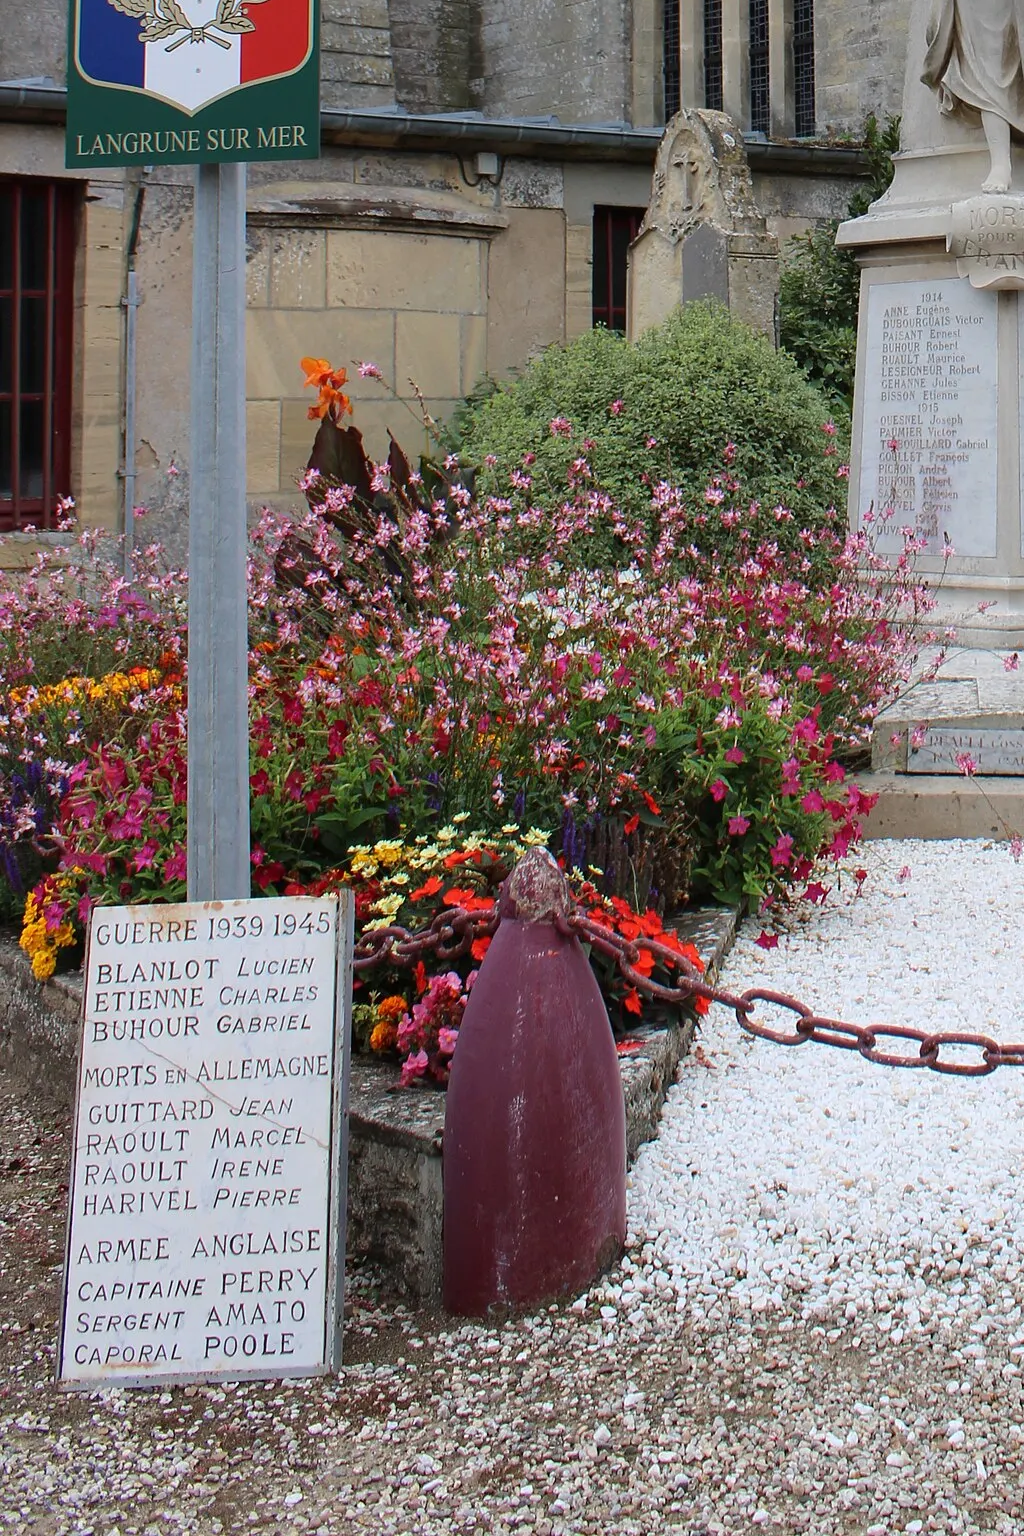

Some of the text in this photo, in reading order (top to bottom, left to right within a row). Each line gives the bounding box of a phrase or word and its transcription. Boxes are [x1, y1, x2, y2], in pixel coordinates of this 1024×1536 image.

[75, 125, 307, 155] LANGRUNE SUR MER
[977, 232, 1015, 243] POUR
[921, 292, 943, 302] 1914
[884, 305, 950, 317] ANNE Eugène
[956, 316, 983, 324] Victor
[930, 329, 961, 339] Ernest
[883, 341, 958, 352] BUHOUR Robert
[882, 354, 966, 364] RUAULT Maurice
[882, 365, 980, 377] LESEIGNEUR Robert
[932, 377, 958, 388] Jules
[881, 391, 915, 401] BISSON
[918, 403, 938, 412] 1915
[930, 414, 963, 425] Joseph
[880, 427, 957, 437] PAUMIER Victor
[956, 440, 988, 449] Gabriel
[919, 465, 947, 475] André
[879, 477, 952, 487] BUHOUR Albert
[96, 911, 330, 945] GUERRE 1939 1945
[97, 957, 315, 984] BLANLOT LUCIEN
[94, 986, 318, 1013] ETIENNE CHARLES
[92, 1014, 311, 1043] BUHOUR GABRIEL
[84, 1055, 329, 1089] MORTS EN ALLEMAGNE
[89, 1096, 294, 1124] GUITTARD JEAN
[86, 1127, 306, 1156] RAOULT MARCEL
[85, 1159, 284, 1186] RAOULT IRENE
[83, 1188, 302, 1216] HARIVEL PIERRE
[77, 1229, 321, 1264] ARMEE ANGLAISE
[78, 1267, 318, 1302] CAPITAINE PERRY
[77, 1300, 305, 1334] SERGENT AMATO
[74, 1333, 295, 1365] CAPORAL POOLE
